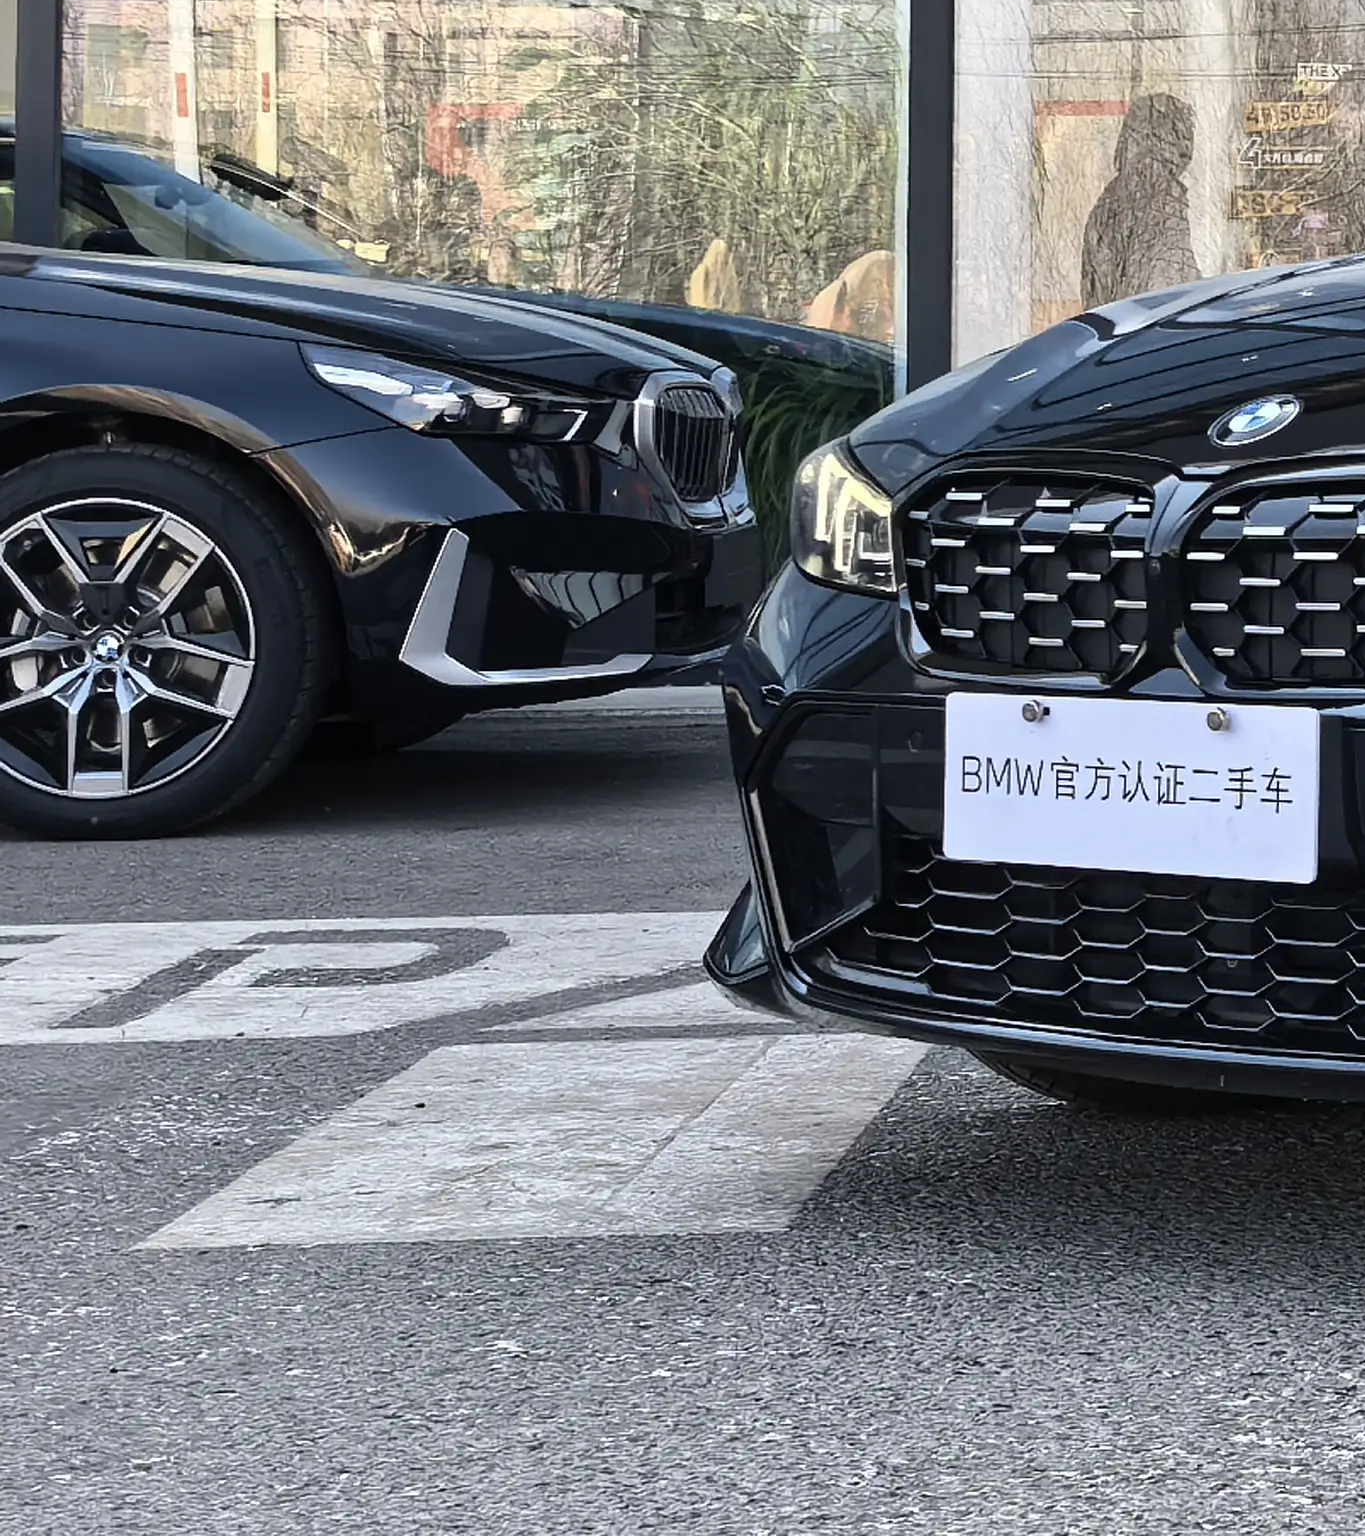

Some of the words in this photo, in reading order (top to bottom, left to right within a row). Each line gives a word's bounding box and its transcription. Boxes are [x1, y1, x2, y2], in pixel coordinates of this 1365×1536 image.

[960, 753, 1296, 815] BMW官方认证二手车
